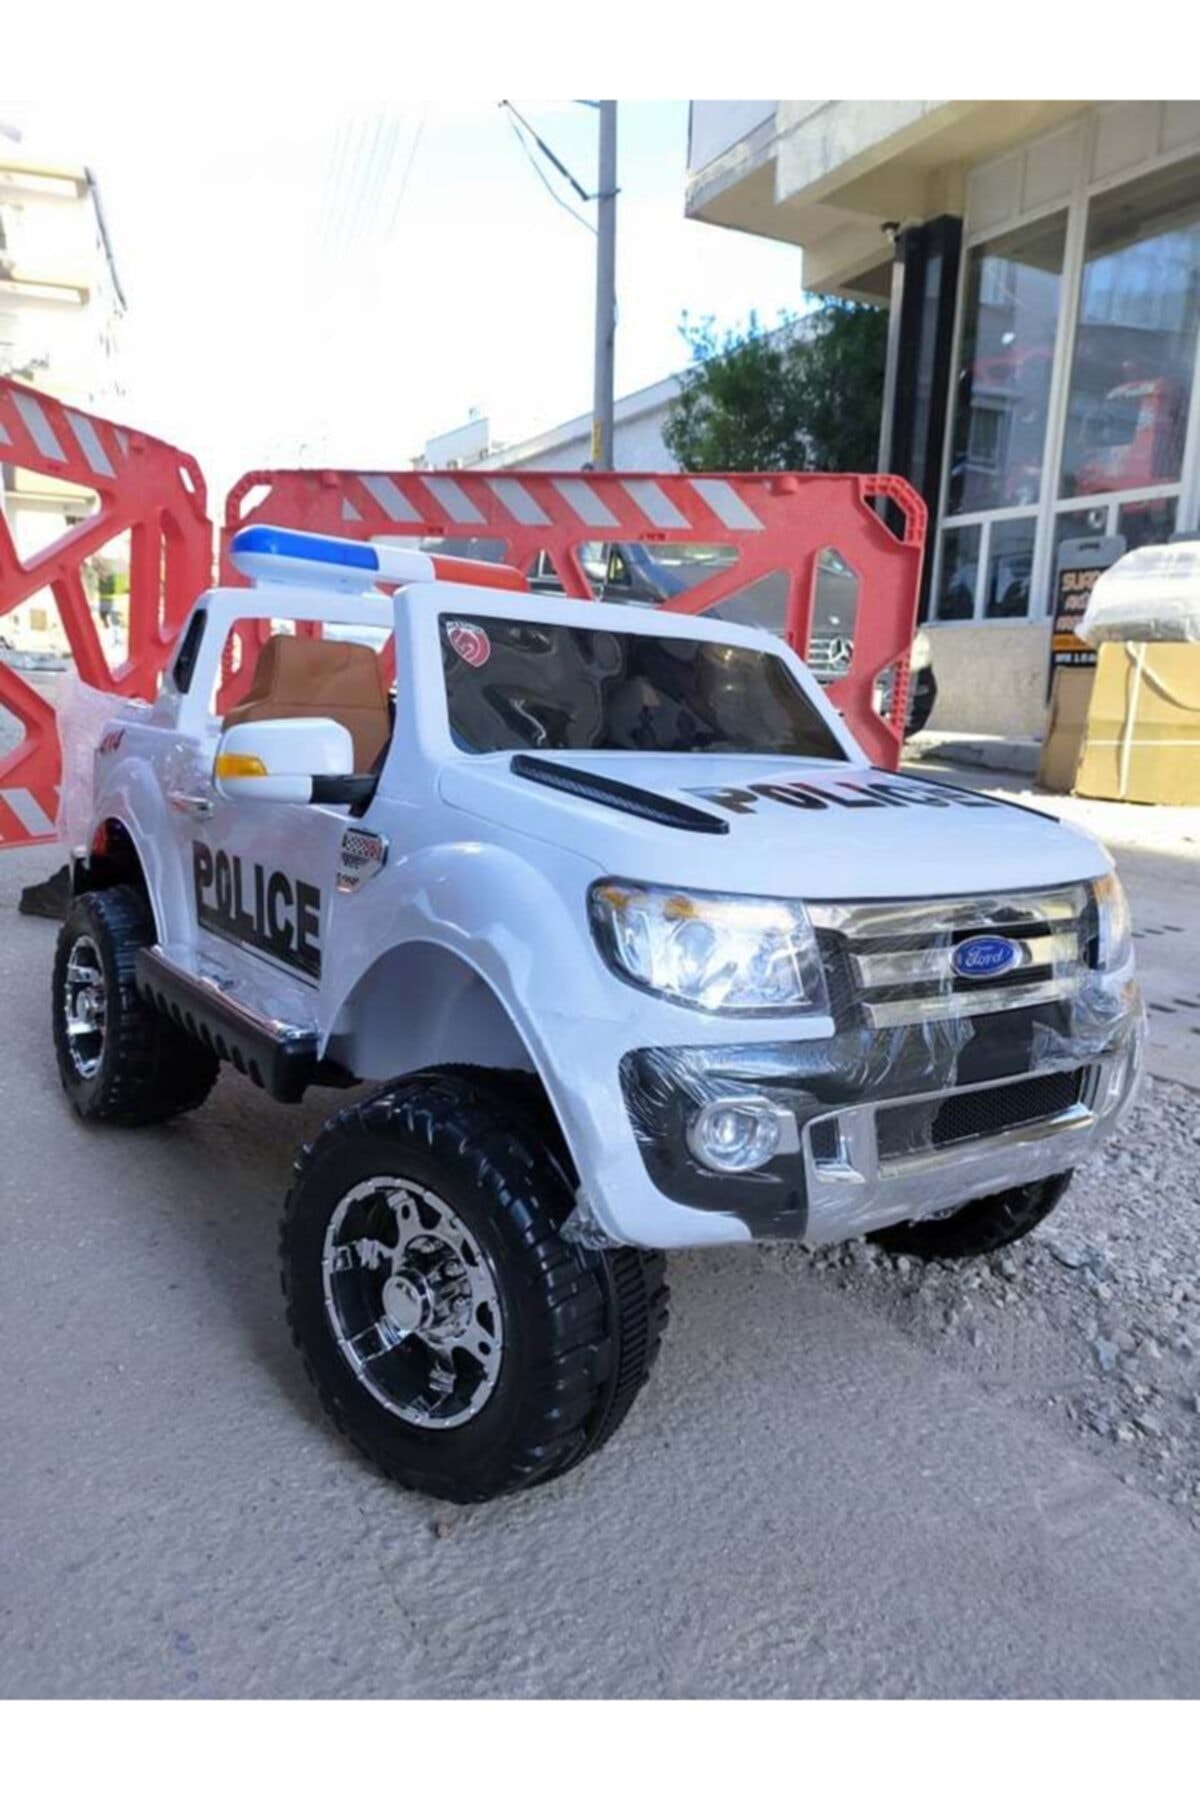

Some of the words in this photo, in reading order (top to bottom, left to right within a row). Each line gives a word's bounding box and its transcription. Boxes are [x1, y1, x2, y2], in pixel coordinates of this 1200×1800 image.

[680, 782, 1001, 814] POLICE
[193, 840, 322, 977] POLICE
[964, 945, 1009, 968] Ford
